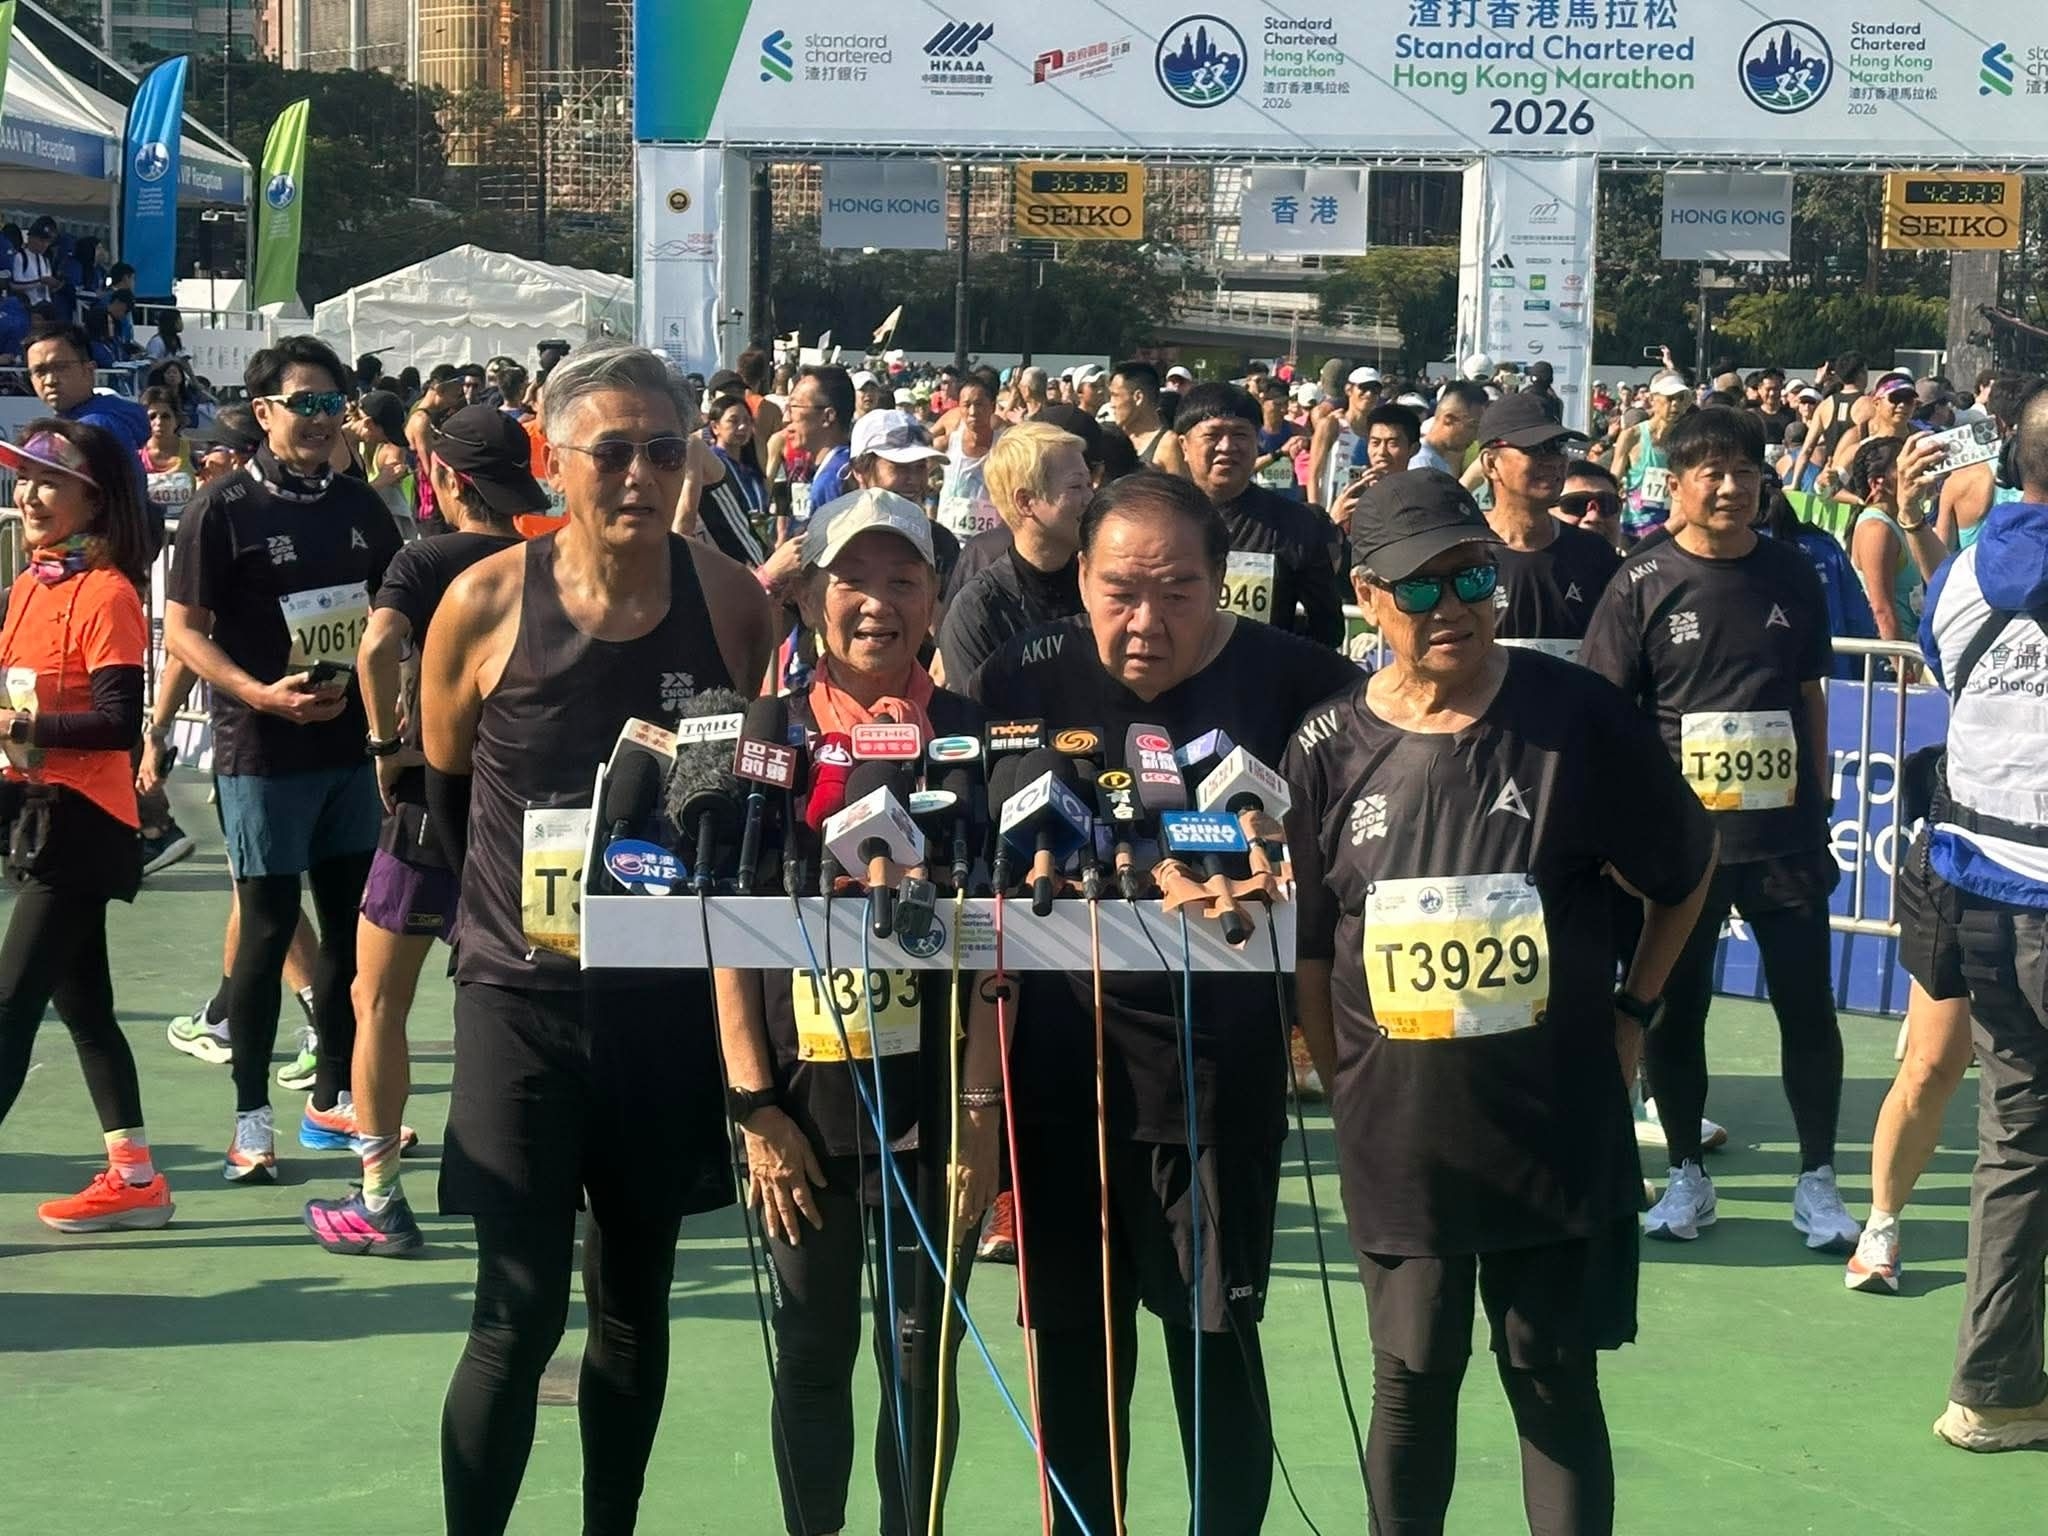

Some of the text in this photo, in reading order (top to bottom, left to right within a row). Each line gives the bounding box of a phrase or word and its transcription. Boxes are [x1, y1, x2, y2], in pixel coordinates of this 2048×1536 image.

[1408, 0, 1678, 30] 渣打香港馬拉松
[1263, 17, 1332, 31] Standard
[1850, 22, 1921, 35] Standard
[805, 34, 887, 49] standard
[1263, 32, 1337, 46] Chartered
[1850, 37, 1926, 51] Chartered
[1395, 34, 1695, 61] Standard Chartered
[805, 49, 892, 64] chartered
[1263, 50, 1344, 65] Hong Kong
[1850, 54, 1933, 71] Hong Kong
[930, 60, 985, 71] HKAAA
[1263, 65, 1336, 77] Marathon
[805, 66, 867, 81] 渣打銀行
[1393, 64, 1695, 95] Hong Kong Marathon
[1850, 71, 1924, 83] Marathon
[1263, 82, 1350, 95] 渣打香港馬拉松
[1849, 87, 1938, 100] 渣打香港馬拉松
[1262, 98, 1292, 109] 2026
[1848, 103, 1877, 115] 2026
[1488, 99, 1595, 135] 2026
[828, 198, 940, 214] HONG KONG
[1271, 196, 1338, 225] 香港
[1027, 206, 1132, 227] SEIKO
[1670, 209, 1785, 225] HONG KONG
[1900, 216, 2007, 237] SEIKO
[221, 483, 248, 503] AKIV
[953, 515, 994, 531] 14326
[1628, 559, 1659, 583] AKIV
[1021, 634, 1064, 666] AKIV
[684, 719, 738, 734] TMHK
[860, 730, 910, 738] RTHK
[991, 721, 1039, 738] now
[1298, 709, 1341, 755] AKIV
[1690, 748, 1792, 782] T3938
[1168, 823, 1236, 835] CHINA
[1174, 833, 1235, 843] DAILY
[1375, 934, 1539, 992] T3929
